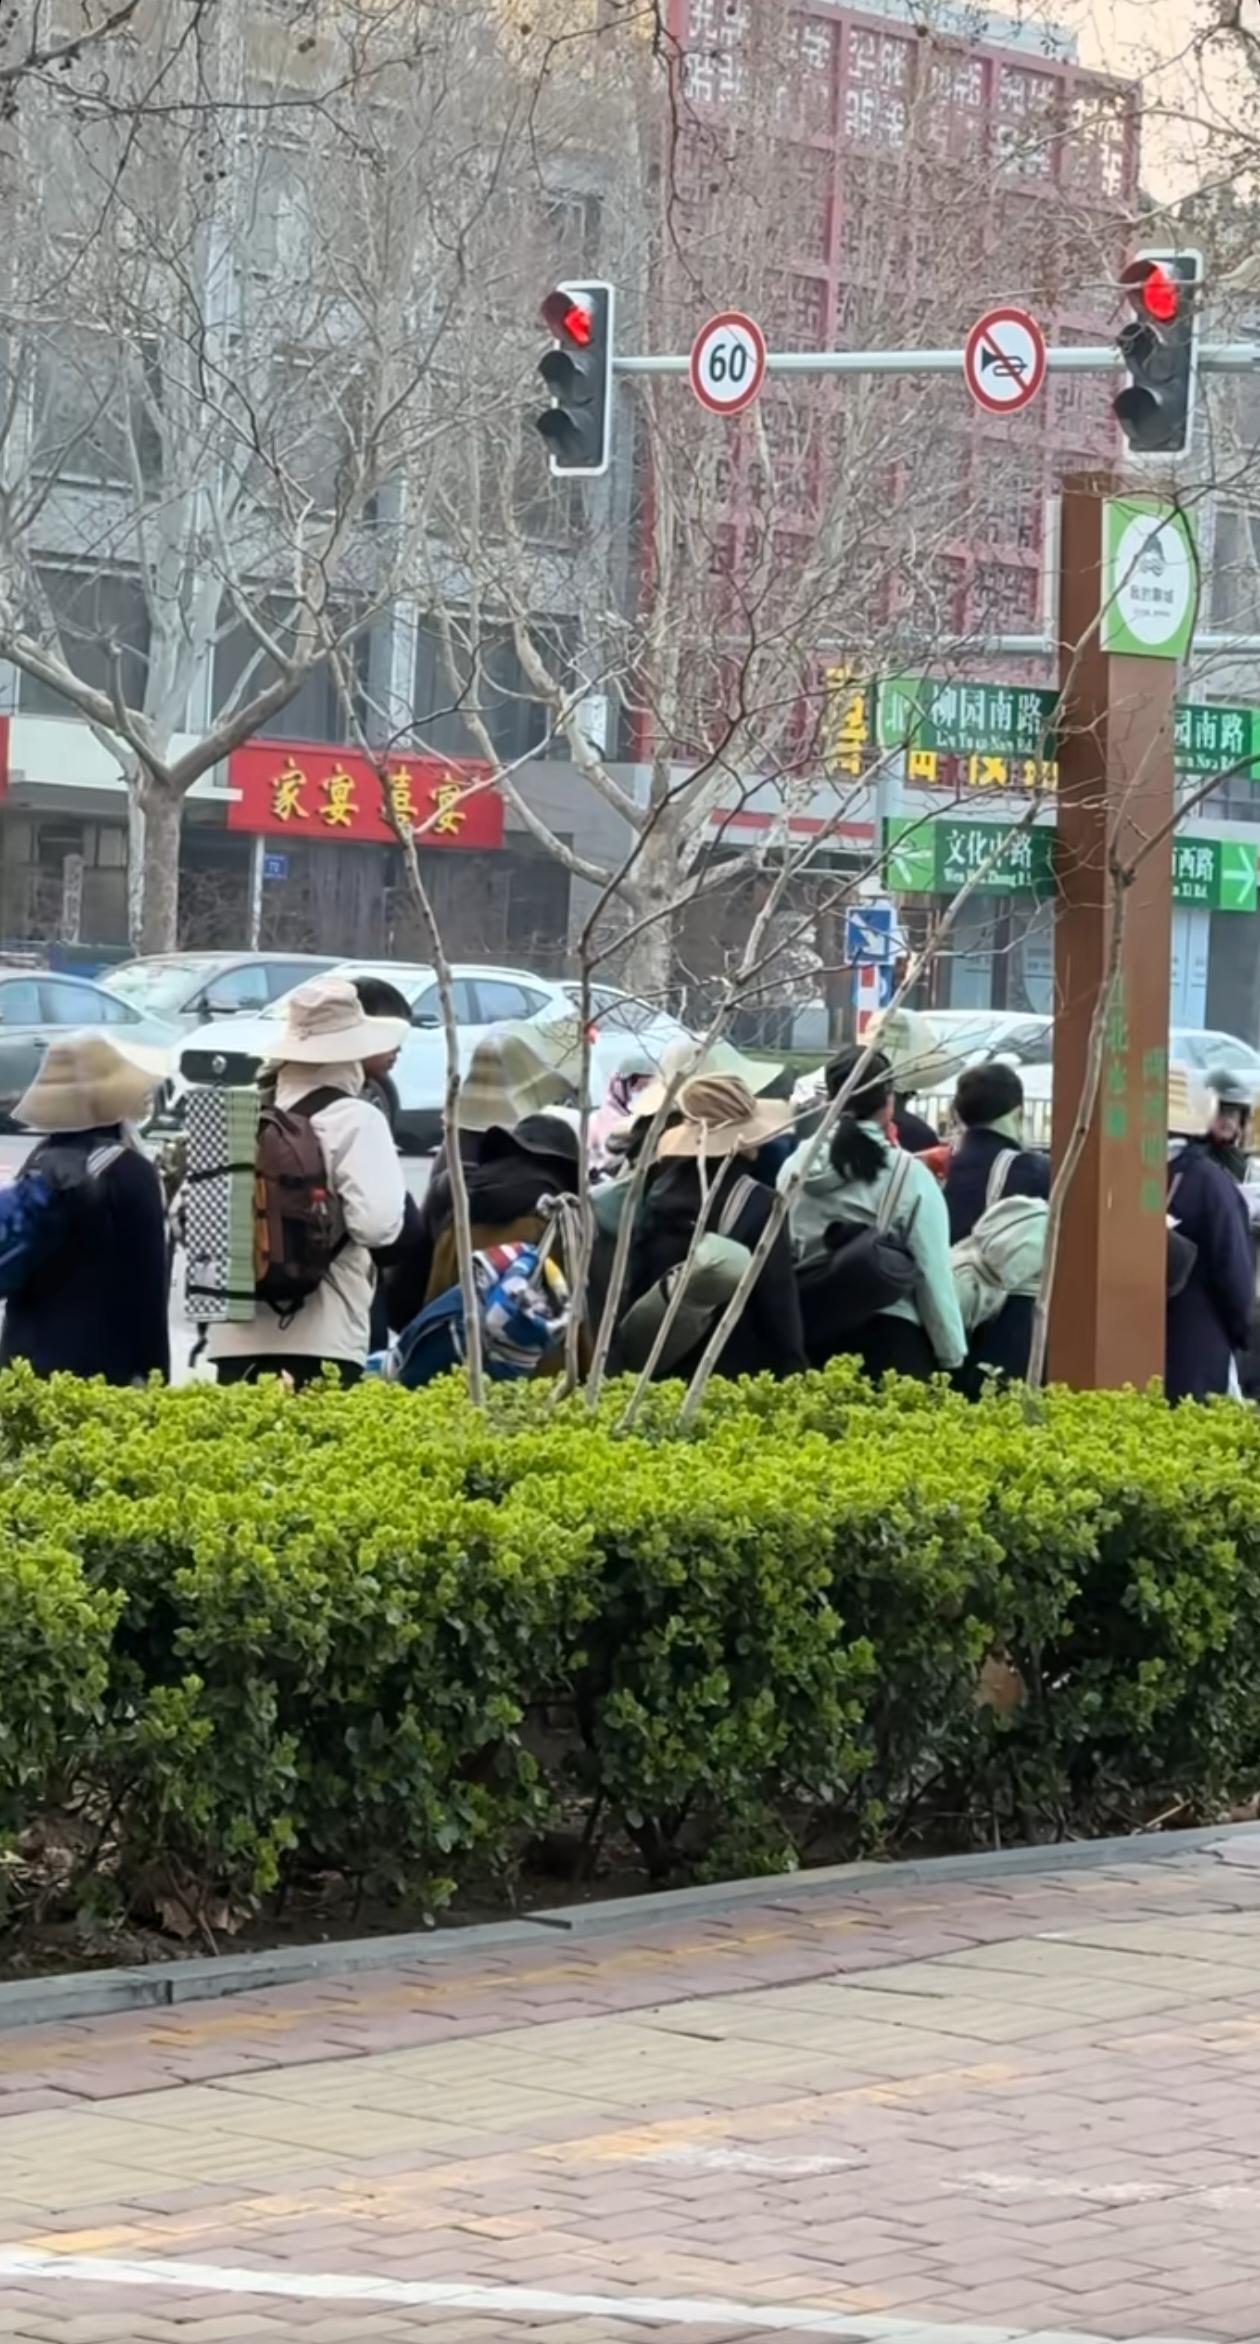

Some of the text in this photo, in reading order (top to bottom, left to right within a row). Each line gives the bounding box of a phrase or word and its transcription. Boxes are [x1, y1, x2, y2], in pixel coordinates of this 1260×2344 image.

[708, 343, 747, 382] 60
[931, 683, 1042, 735] 柳园南路
[943, 828, 1033, 868] 文化中路
